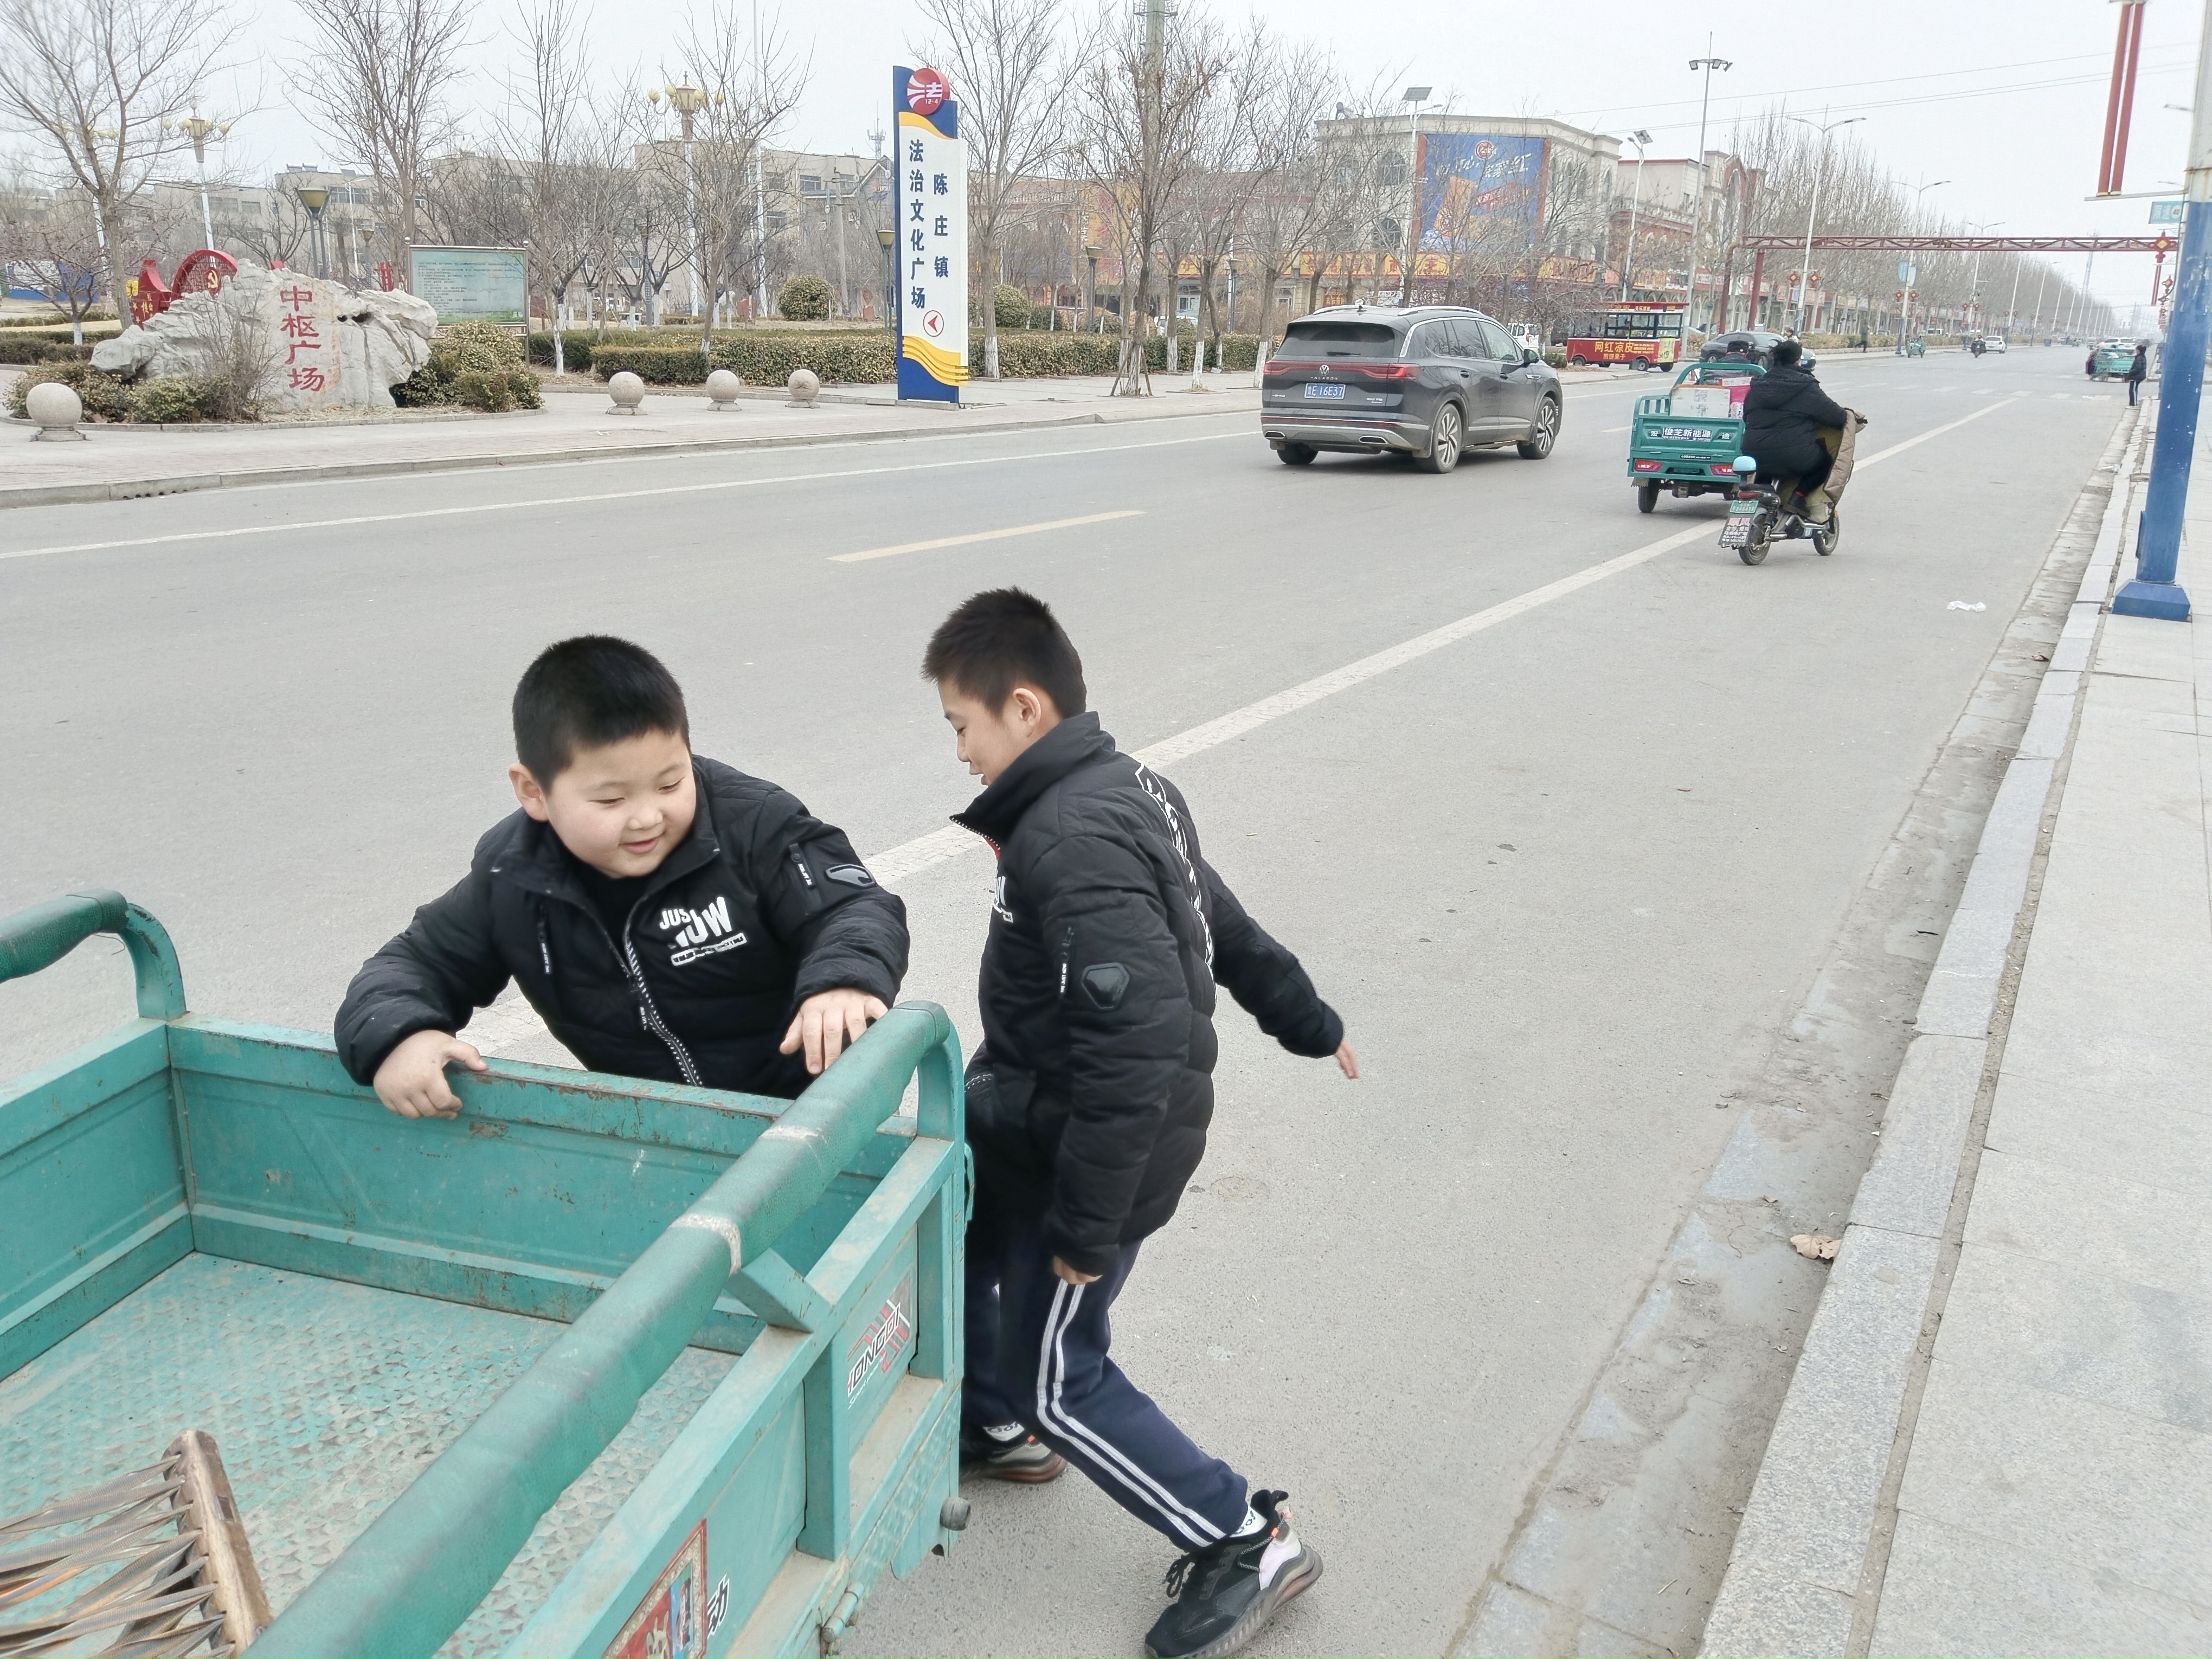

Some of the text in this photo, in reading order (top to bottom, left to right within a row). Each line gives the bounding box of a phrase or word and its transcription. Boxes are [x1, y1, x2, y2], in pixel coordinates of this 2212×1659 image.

[909, 139, 925, 308] 法治文化广场
[934, 173, 948, 278] 陈庄镇
[280, 286, 324, 391] 中枢广场
[1594, 341, 1634, 353] 网红凉皮
[1664, 428, 1712, 438] 俊芝新能源
